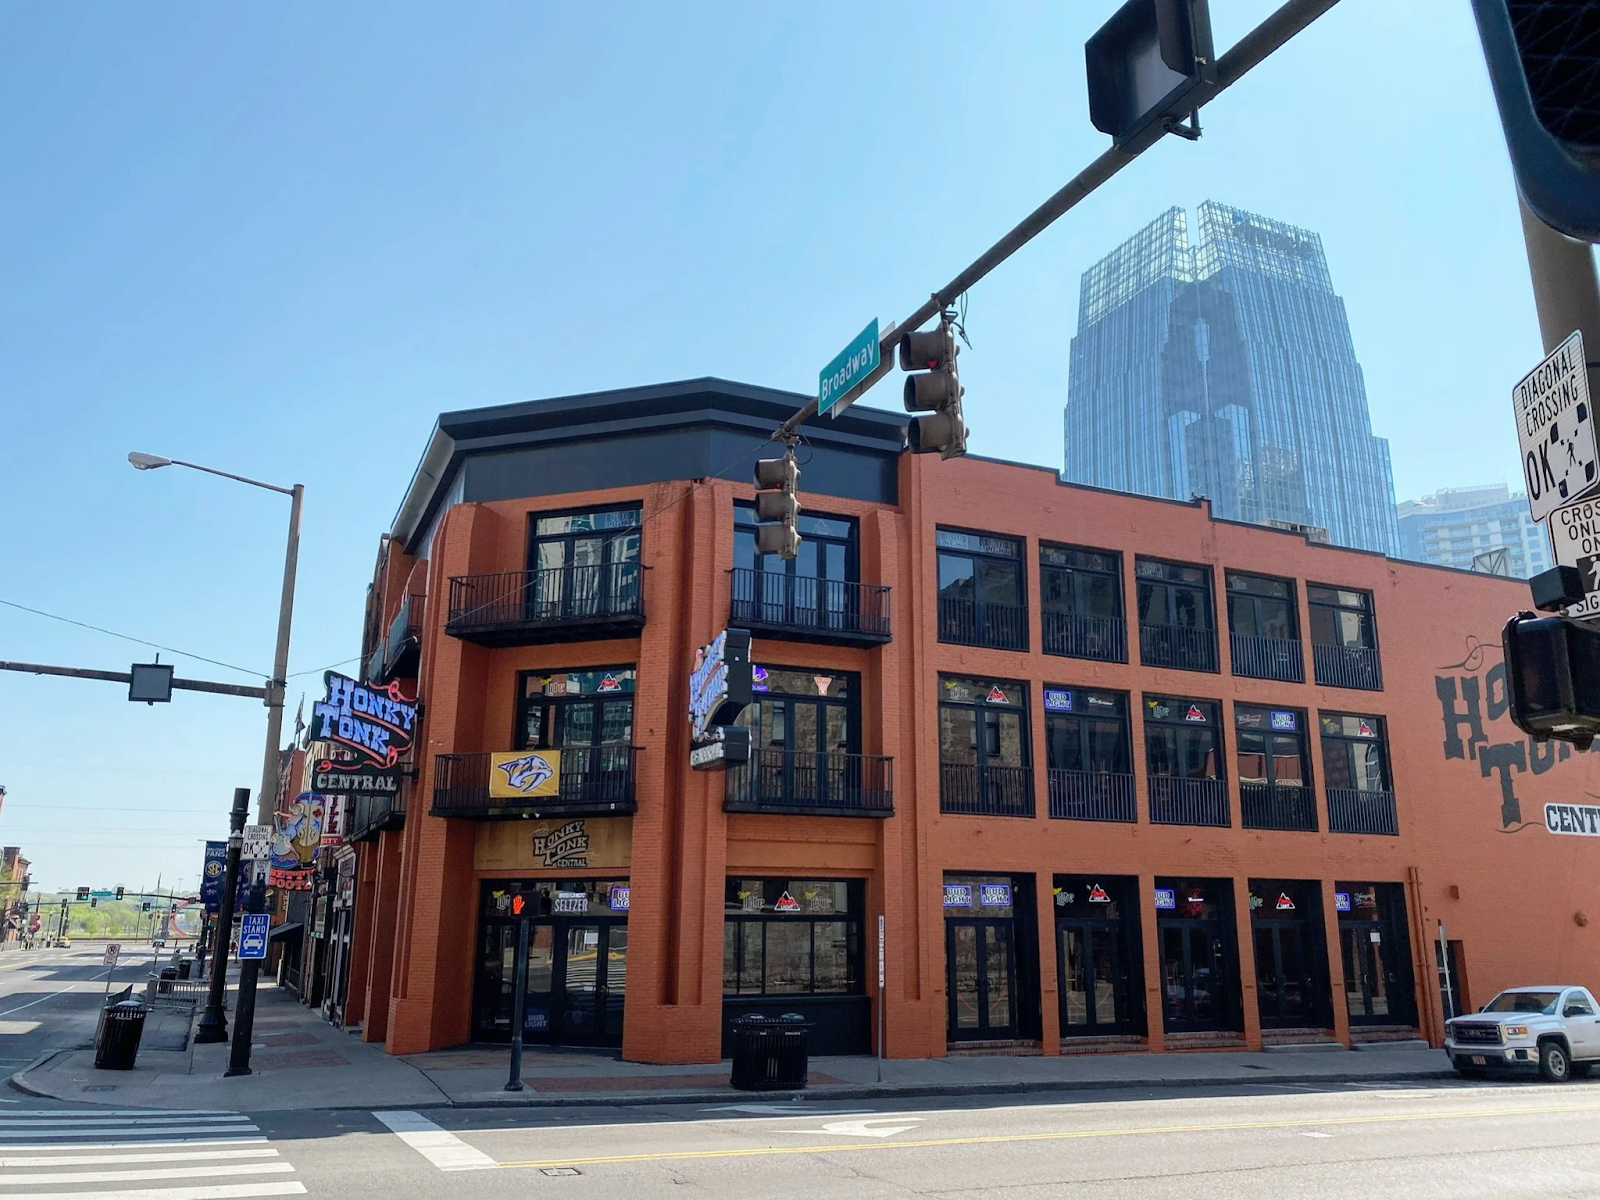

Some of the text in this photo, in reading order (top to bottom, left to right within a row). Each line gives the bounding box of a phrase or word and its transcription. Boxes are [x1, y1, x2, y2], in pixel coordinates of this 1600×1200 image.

[822, 340, 874, 400] Broadway
[1520, 346, 1576, 410] DIAGONAL
[1525, 375, 1578, 437] CROSSING
[1526, 438, 1557, 501] OK
[328, 675, 415, 730] HONKY
[315, 702, 390, 756] TONK
[316, 773, 397, 791] CENTRAL
[1545, 805, 1600, 834] CENT
[534, 821, 583, 855] HONKY
[243, 842, 254, 855] OK
[543, 836, 588, 866] TONK
[207, 862, 220, 876] SEC
[557, 859, 587, 867] CENTRAL
[947, 887, 967, 896] BUD
[986, 887, 1005, 896] BUD
[554, 899, 588, 912] SELTZER
[943, 895, 971, 904] LIGHT
[982, 894, 1009, 904] LIGHT
[249, 916, 265, 925] TAXI
[243, 925, 266, 934] STAND
[524, 1020, 548, 1028] LIGHT
